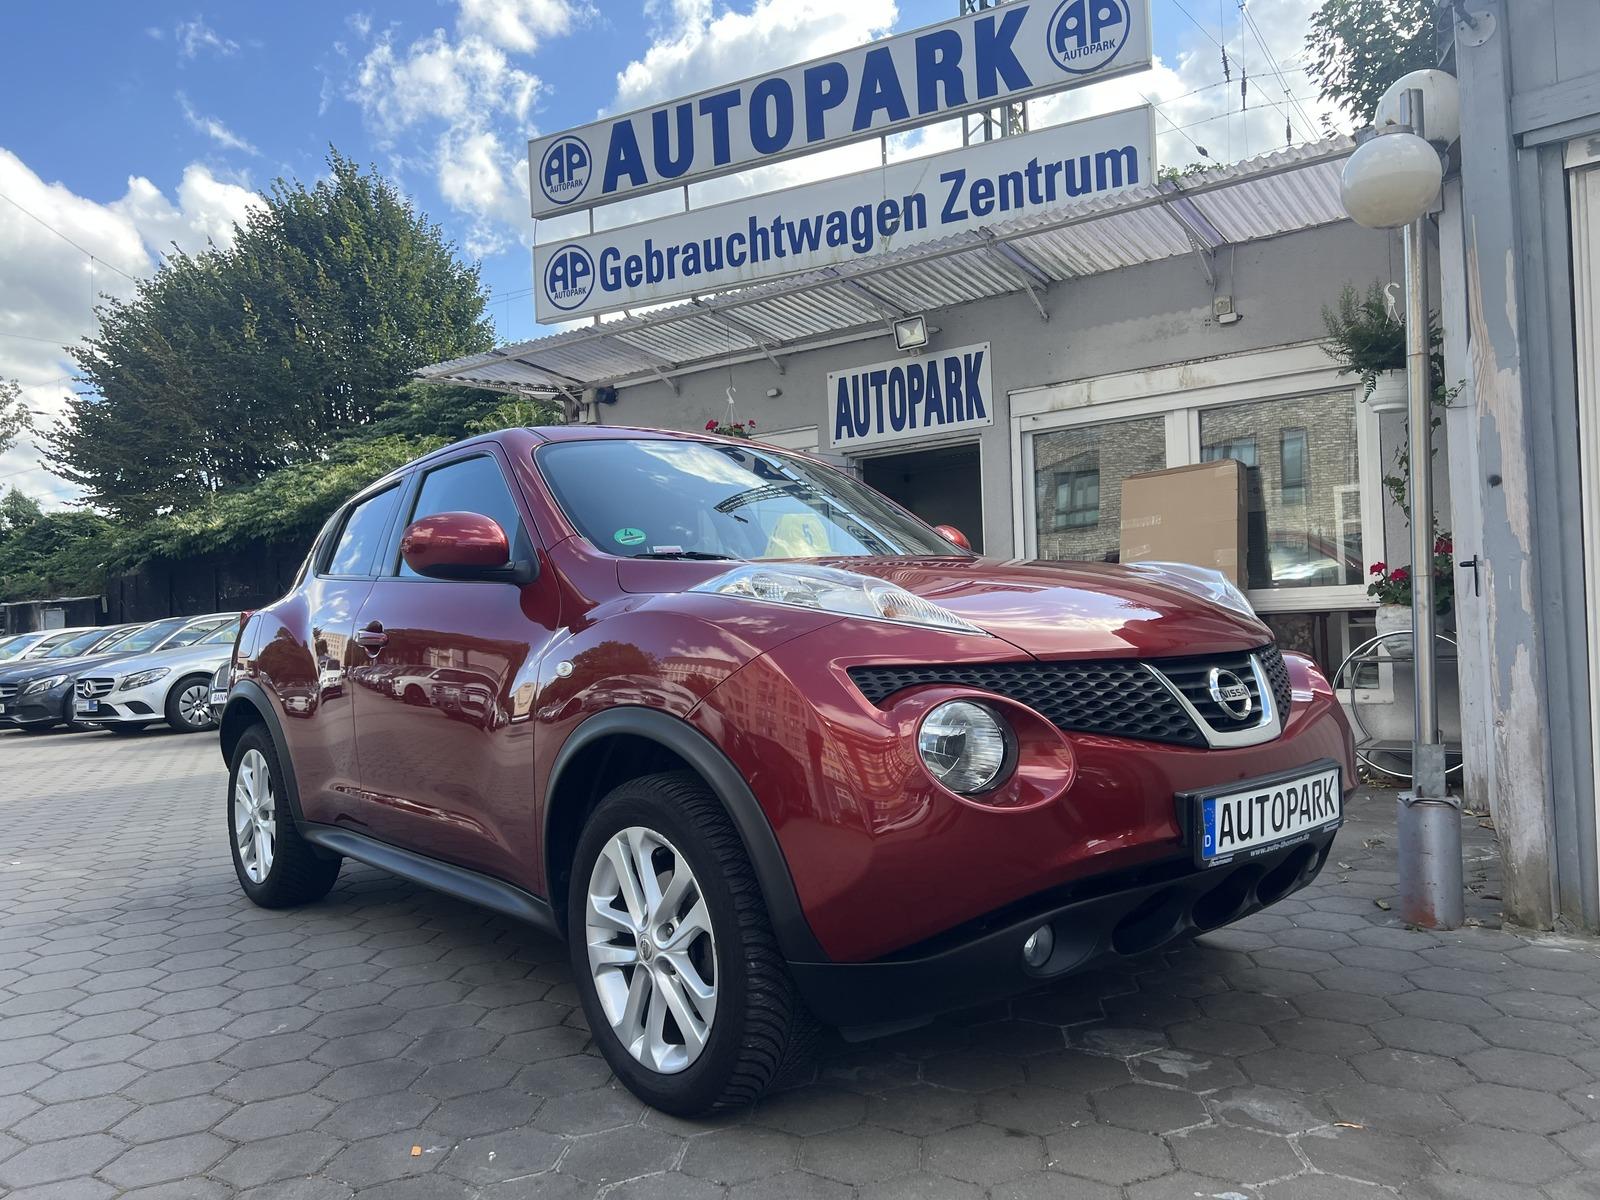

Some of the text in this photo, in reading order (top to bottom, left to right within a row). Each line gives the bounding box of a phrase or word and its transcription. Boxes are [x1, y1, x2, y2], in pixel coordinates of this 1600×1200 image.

[1063, 38, 1116, 62] AUTOPARK
[602, 5, 1033, 194] AUTOPARK
[545, 143, 587, 187] AP
[550, 178, 583, 193] AUTOPARK
[600, 145, 1139, 292] Gebrauchtwagen Zentrum
[550, 251, 590, 293] AP
[554, 286, 587, 300] AUTOPARK
[835, 351, 986, 440] AUTOPARK
[1219, 776, 1336, 848] AUTOPARK
[1204, 834, 1211, 847] D
